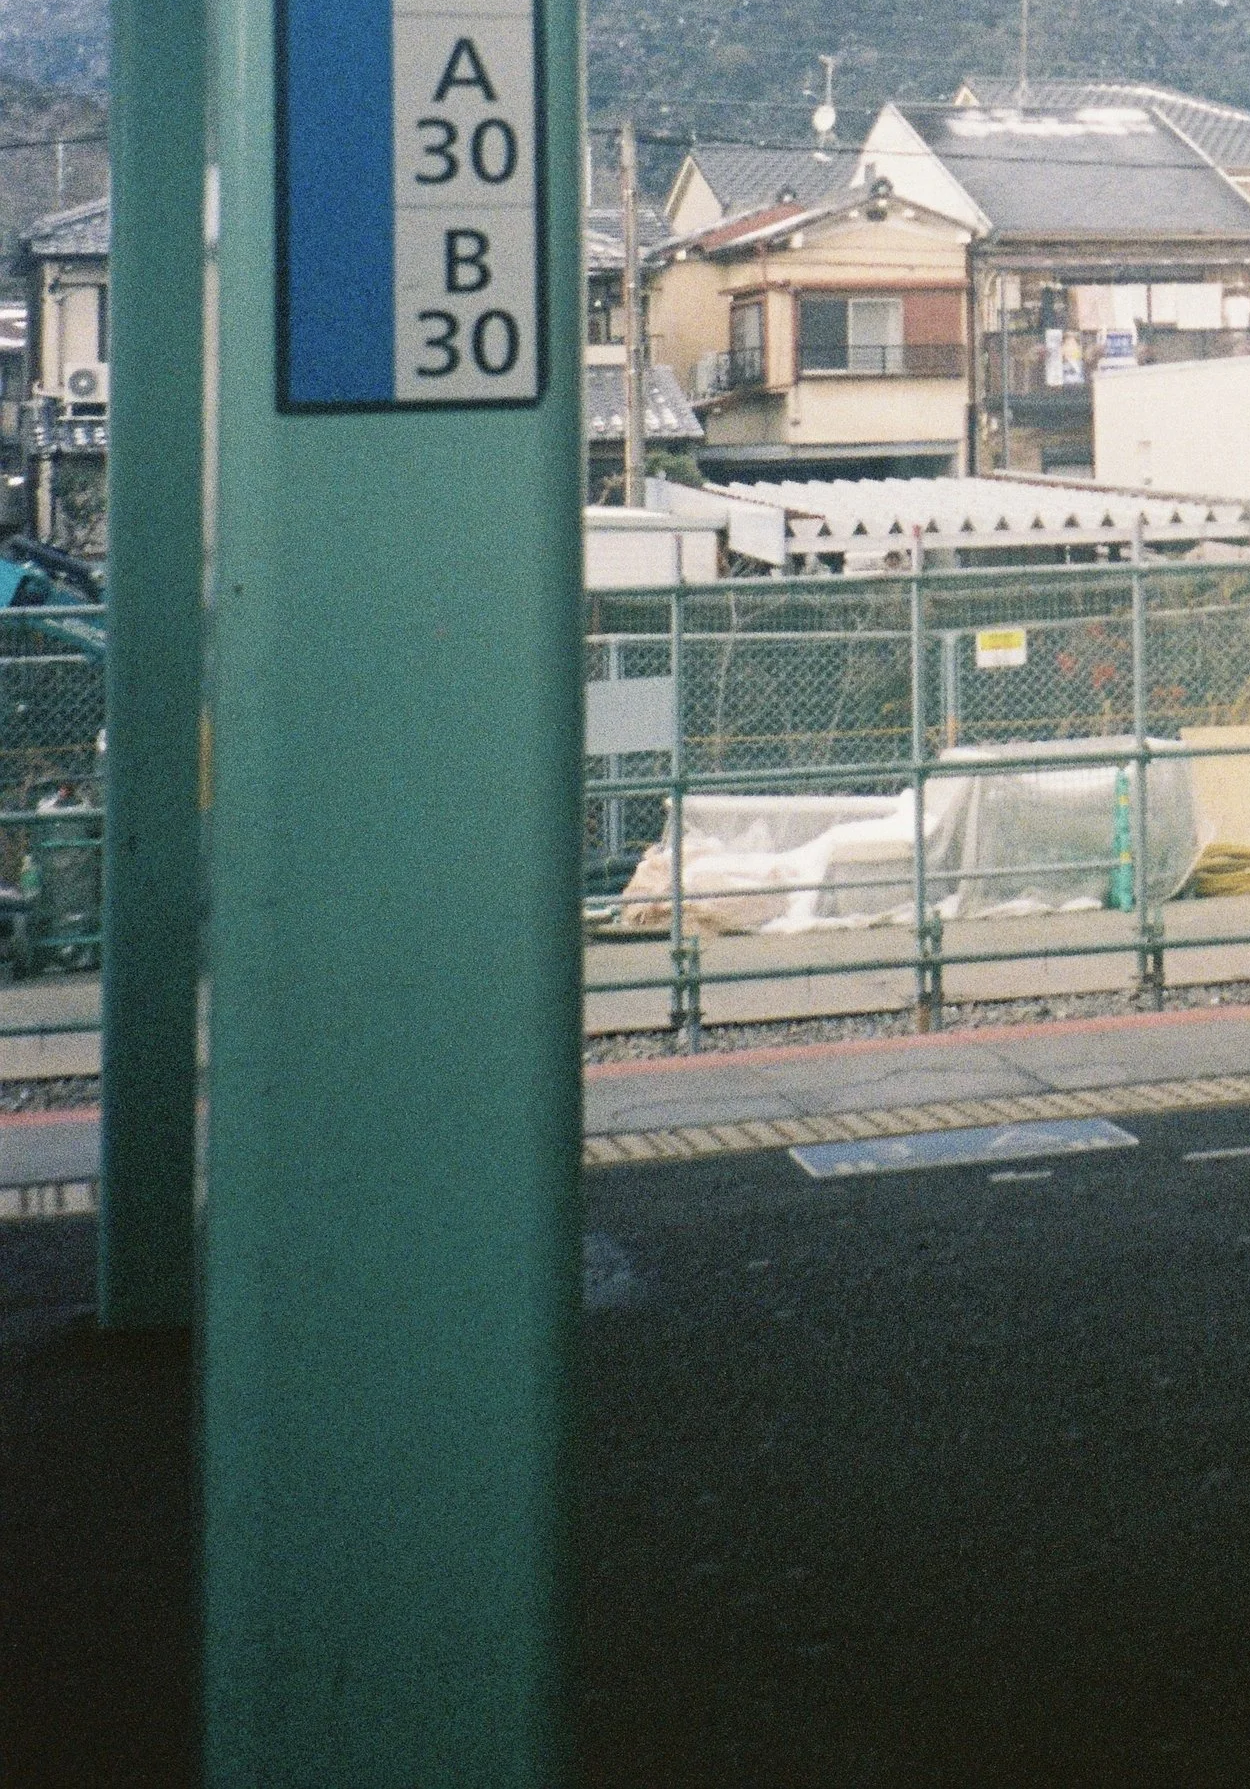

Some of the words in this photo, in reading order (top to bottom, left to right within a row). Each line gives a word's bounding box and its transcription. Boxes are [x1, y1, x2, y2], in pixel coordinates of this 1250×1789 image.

[434, 37, 498, 103] A
[414, 117, 519, 187] 30
[444, 227, 493, 295] B
[414, 308, 521, 380] 30
